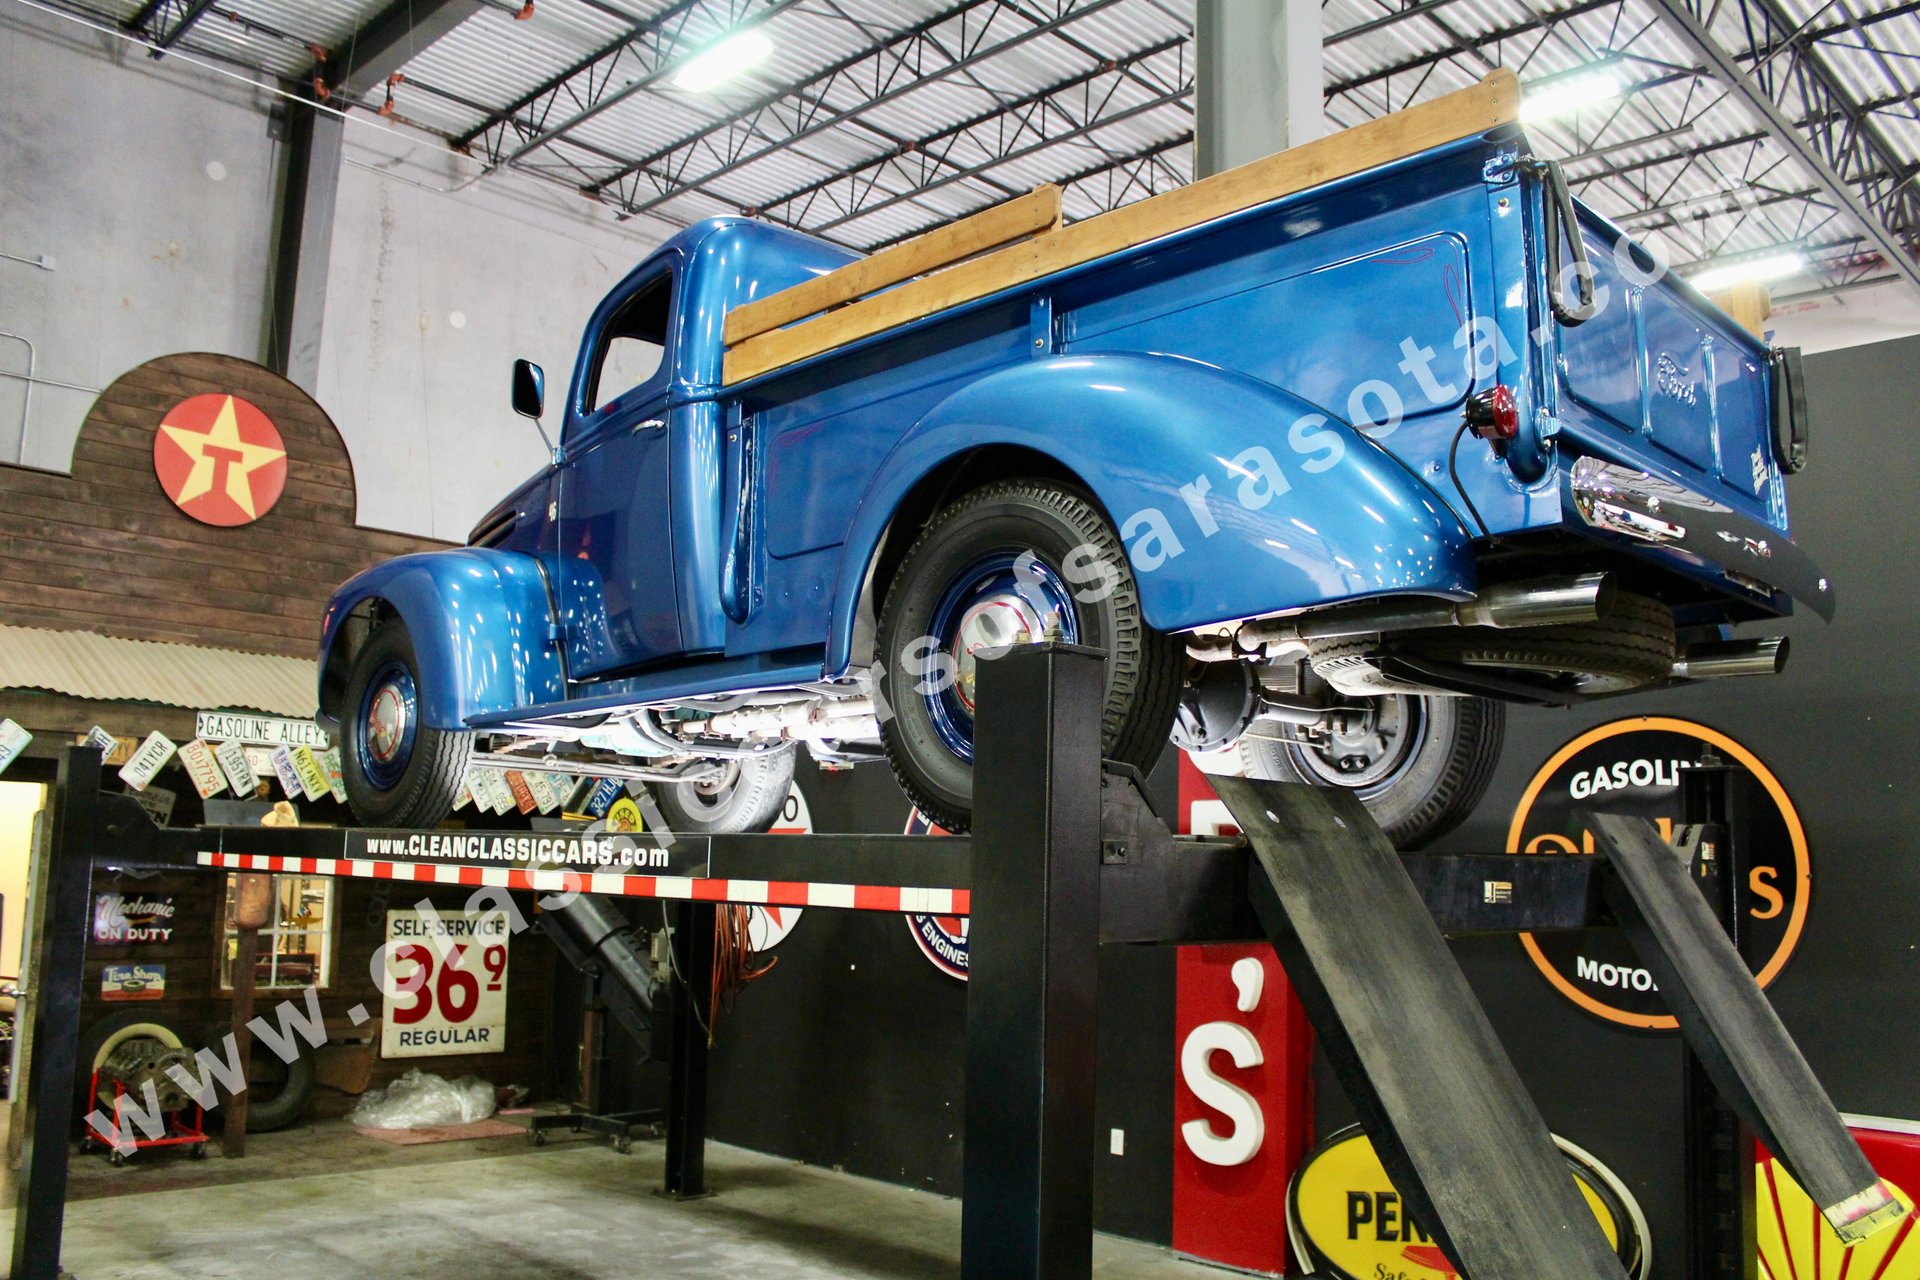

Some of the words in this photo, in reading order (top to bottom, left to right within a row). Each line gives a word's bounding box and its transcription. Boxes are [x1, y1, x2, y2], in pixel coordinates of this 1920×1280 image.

[206, 715, 270, 741] GASOLINE
[280, 722, 323, 745] ALLEY
[1569, 758, 1702, 800] GASOLI
[366, 834, 669, 867] www.CLEANCLASSICCARS.com
[99, 895, 175, 928] Mechanic
[97, 928, 121, 940] ON
[127, 928, 173, 940] DUTY
[105, 967, 132, 983] Tire
[133, 966, 162, 982] Shop
[1577, 955, 1659, 992] MOTO
[400, 1028, 490, 1047] REGULAR
